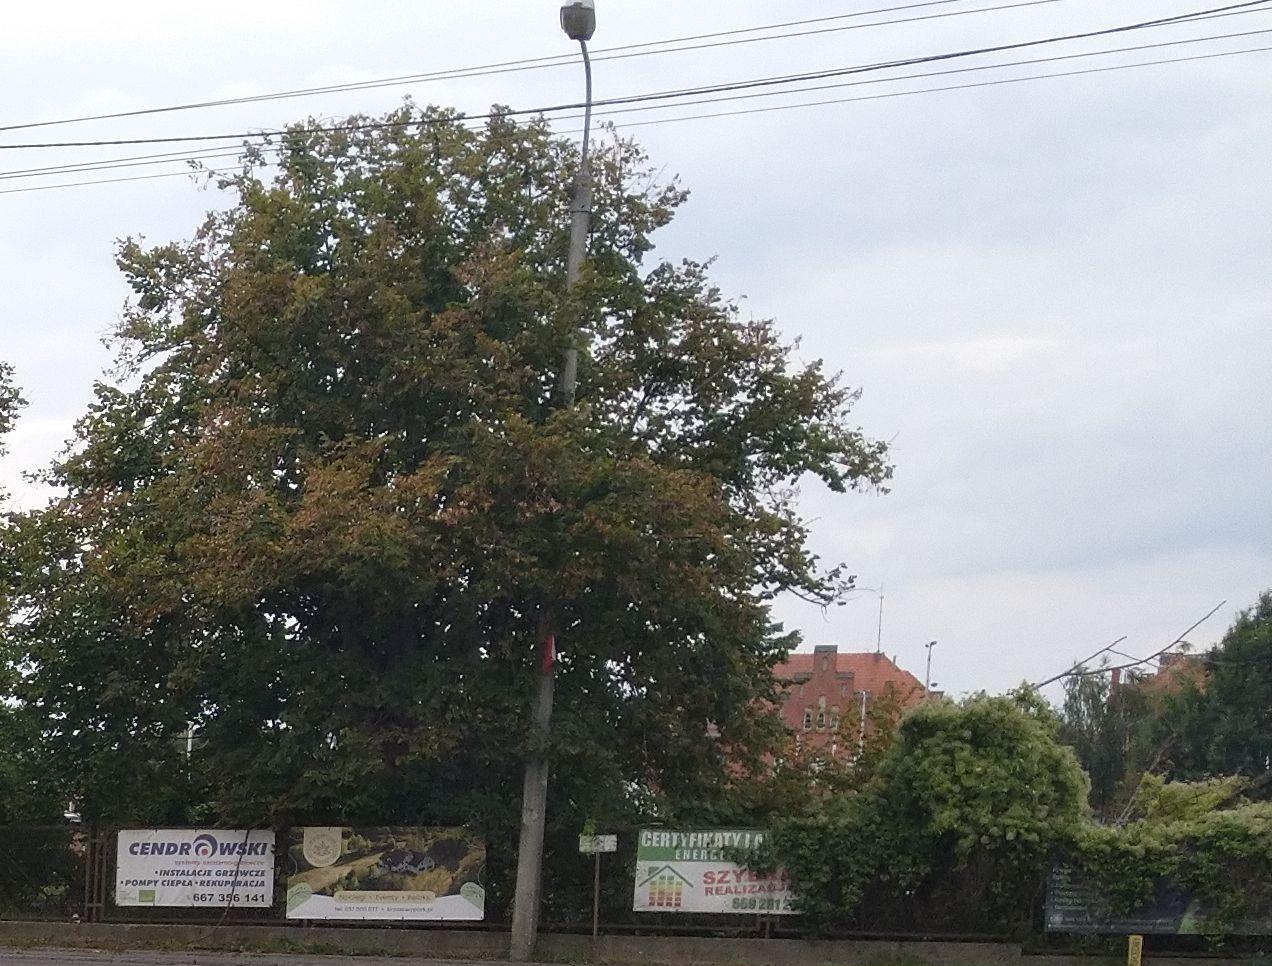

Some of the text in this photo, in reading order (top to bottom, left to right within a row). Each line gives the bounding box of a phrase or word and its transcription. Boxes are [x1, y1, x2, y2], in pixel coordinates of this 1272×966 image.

[641, 831, 742, 848] CERTYFIKATY
[159, 869, 212, 877] INSTALACJE
[125, 879, 159, 887] POMPY
[193, 894, 215, 902] 667
[244, 894, 265, 902] 141
